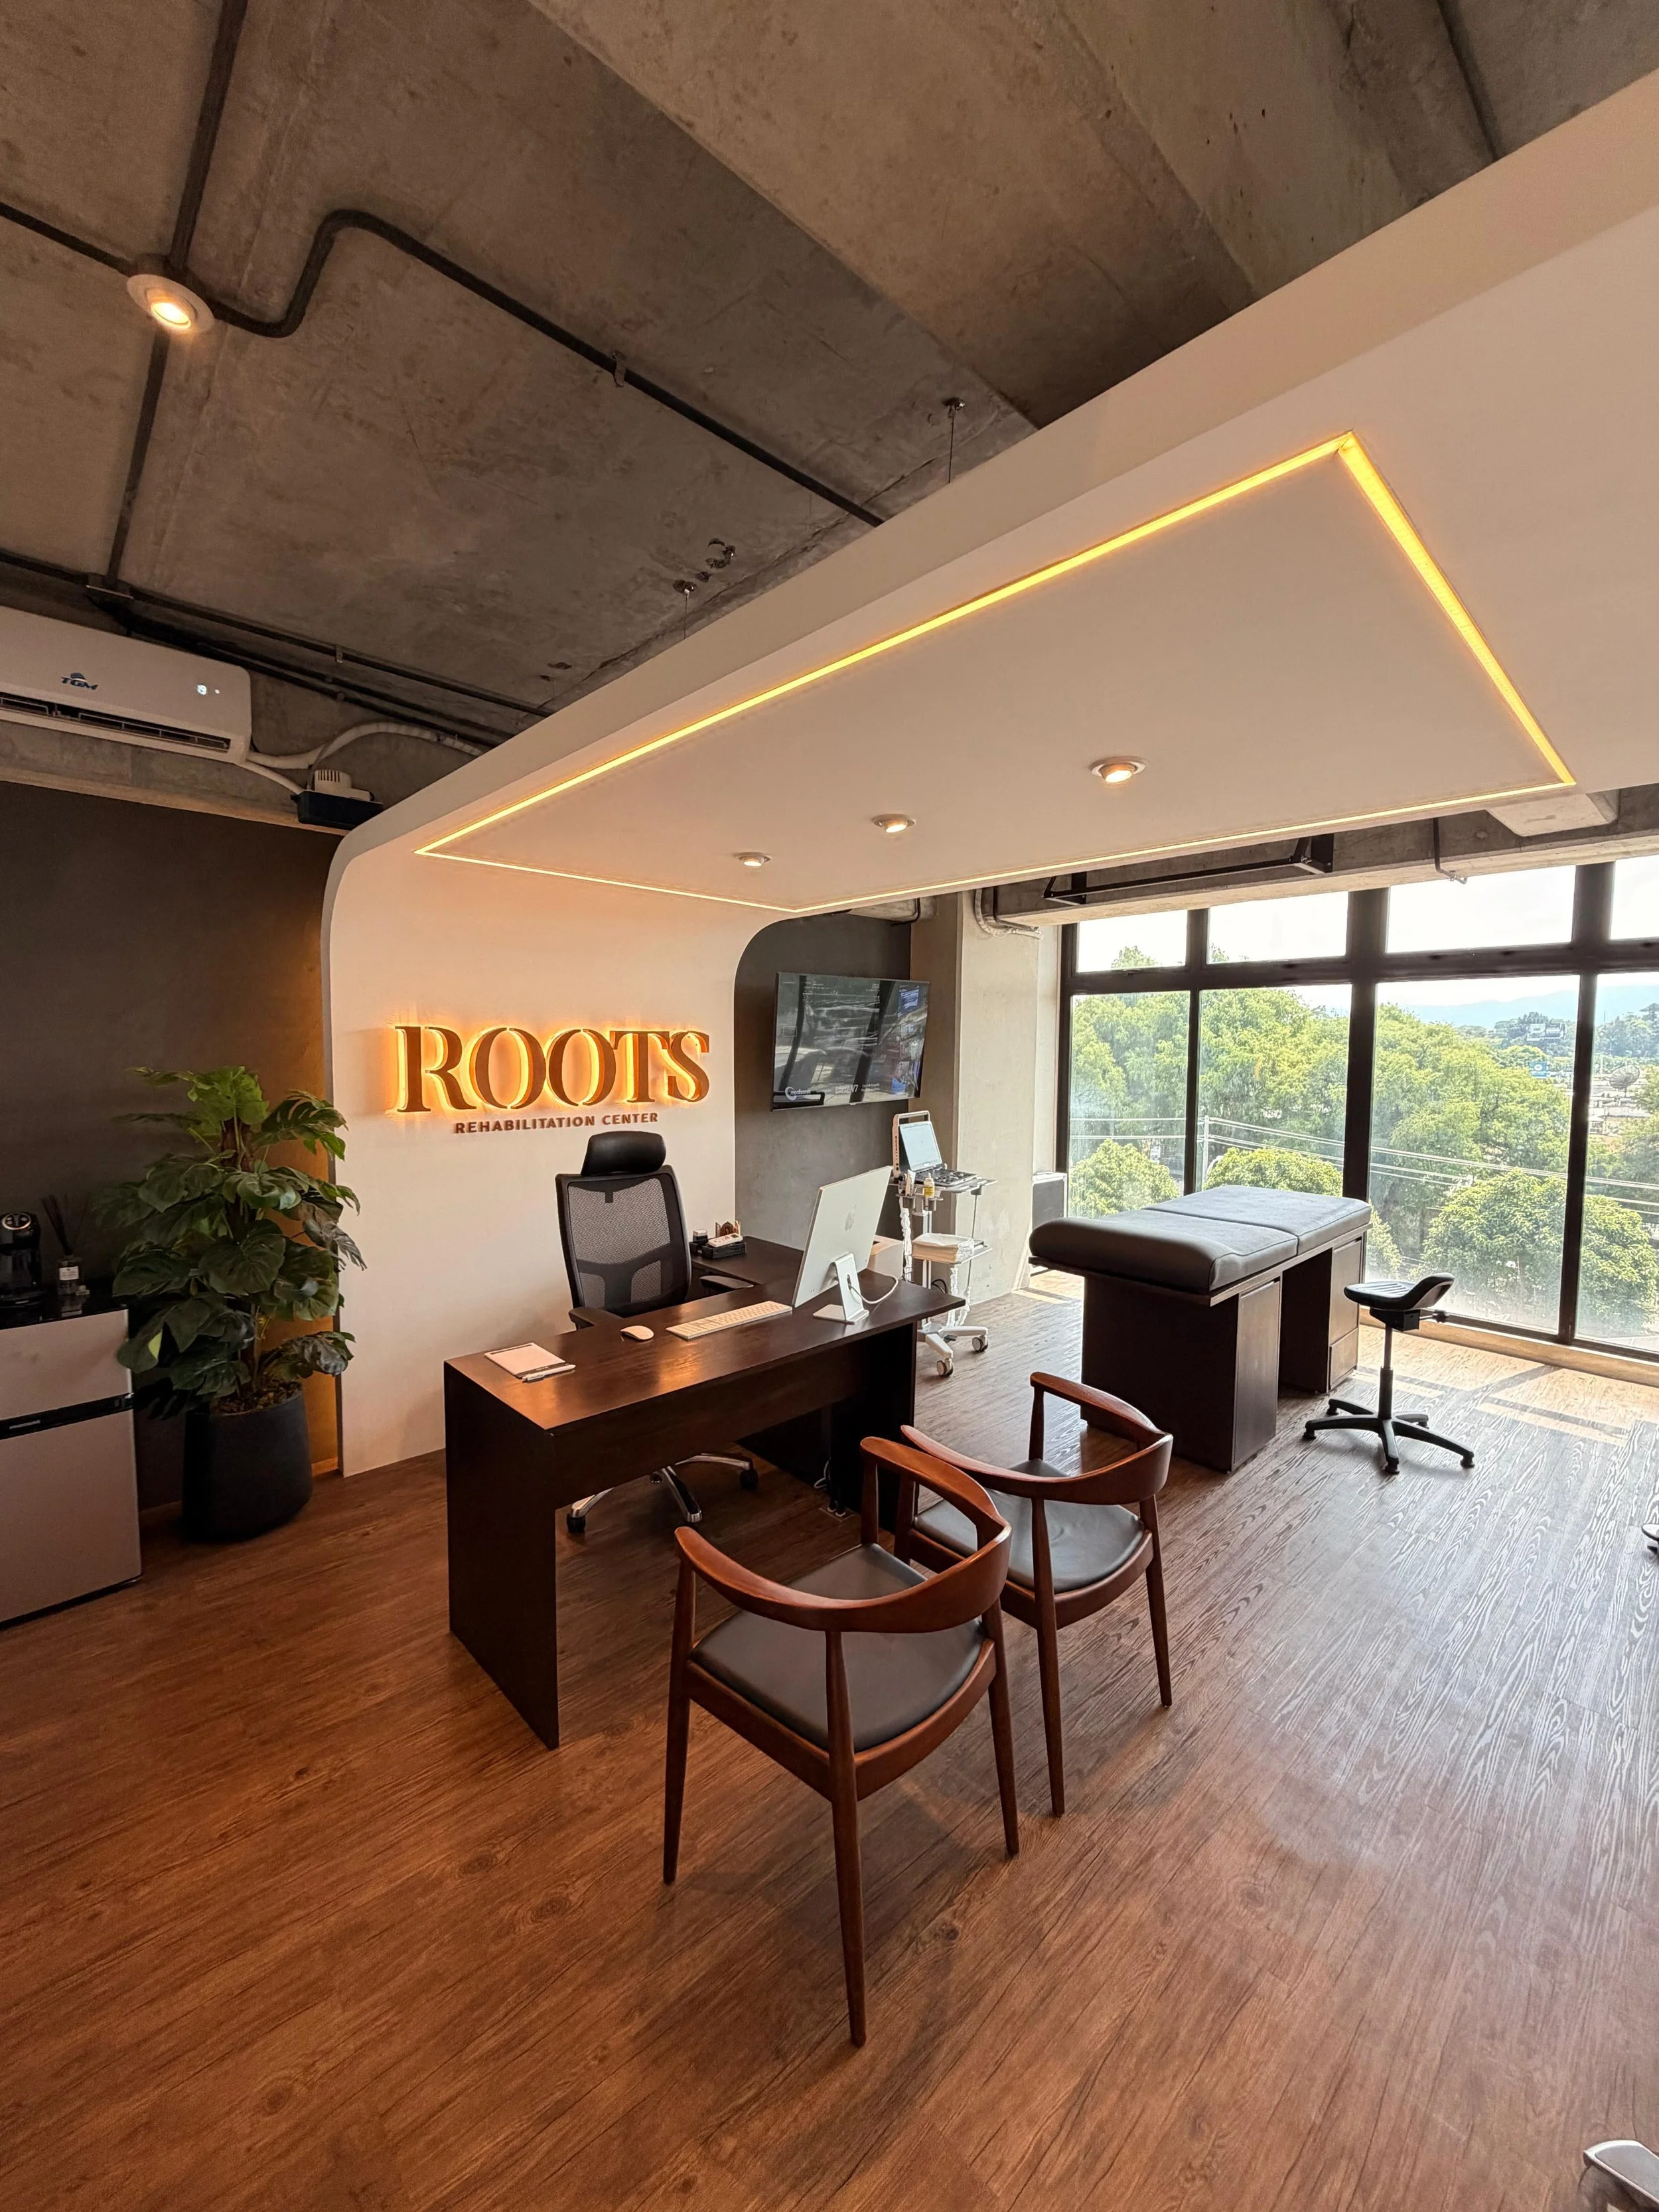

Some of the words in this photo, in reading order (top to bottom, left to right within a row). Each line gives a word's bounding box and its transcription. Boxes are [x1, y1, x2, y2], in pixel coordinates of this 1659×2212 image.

[395, 1025, 710, 1113] ROOTS
[455, 1116, 595, 1134] REHABILITATION
[602, 1112, 658, 1125] CENTER
